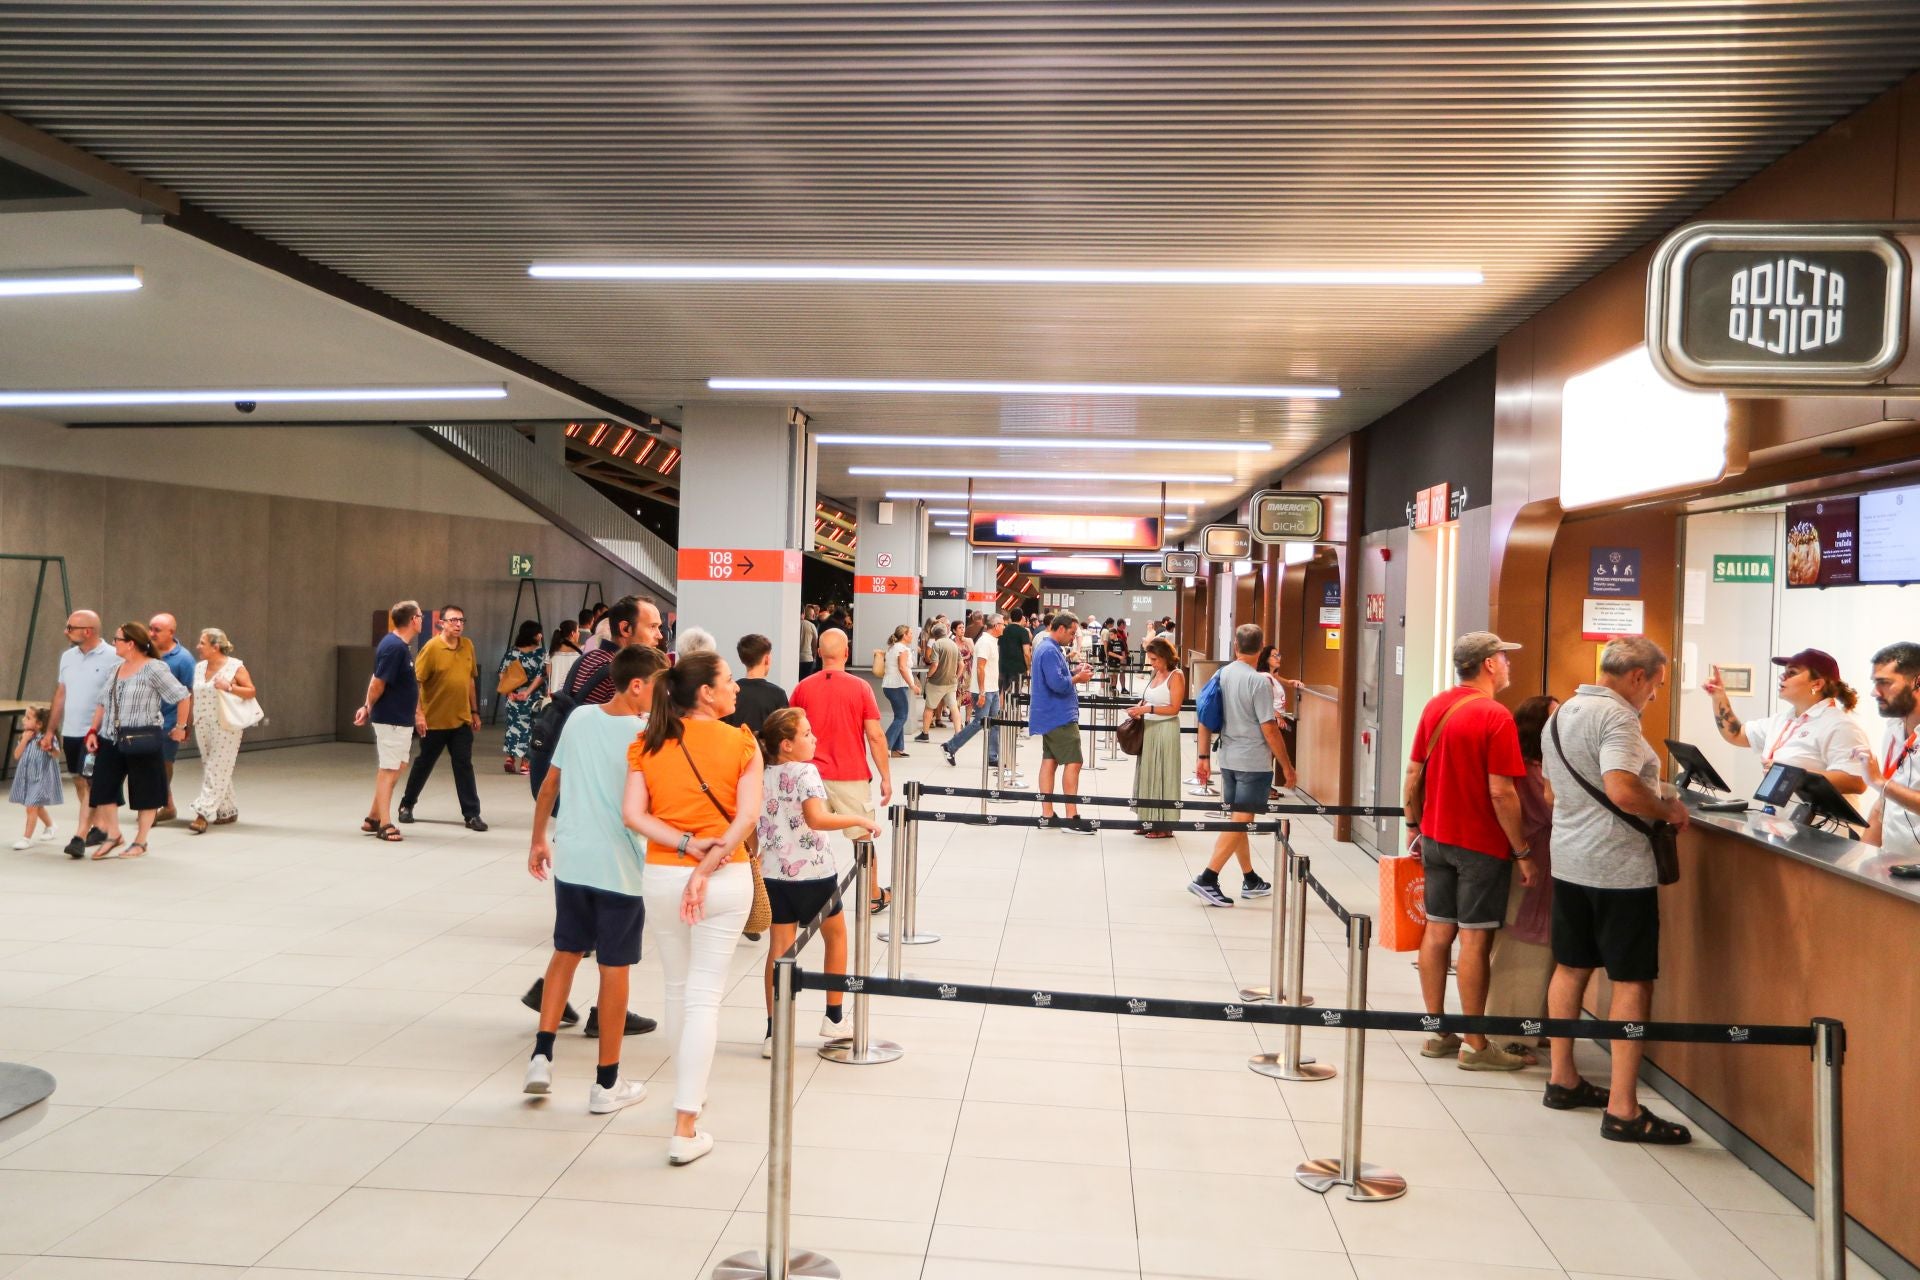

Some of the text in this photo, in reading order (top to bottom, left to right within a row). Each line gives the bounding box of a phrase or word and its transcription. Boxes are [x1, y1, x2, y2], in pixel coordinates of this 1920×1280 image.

[1731, 259, 1844, 306] ADICTA
[708, 552, 732, 564] 108
[708, 566, 732, 578] 109
[1717, 562, 1770, 576] SALIDA
